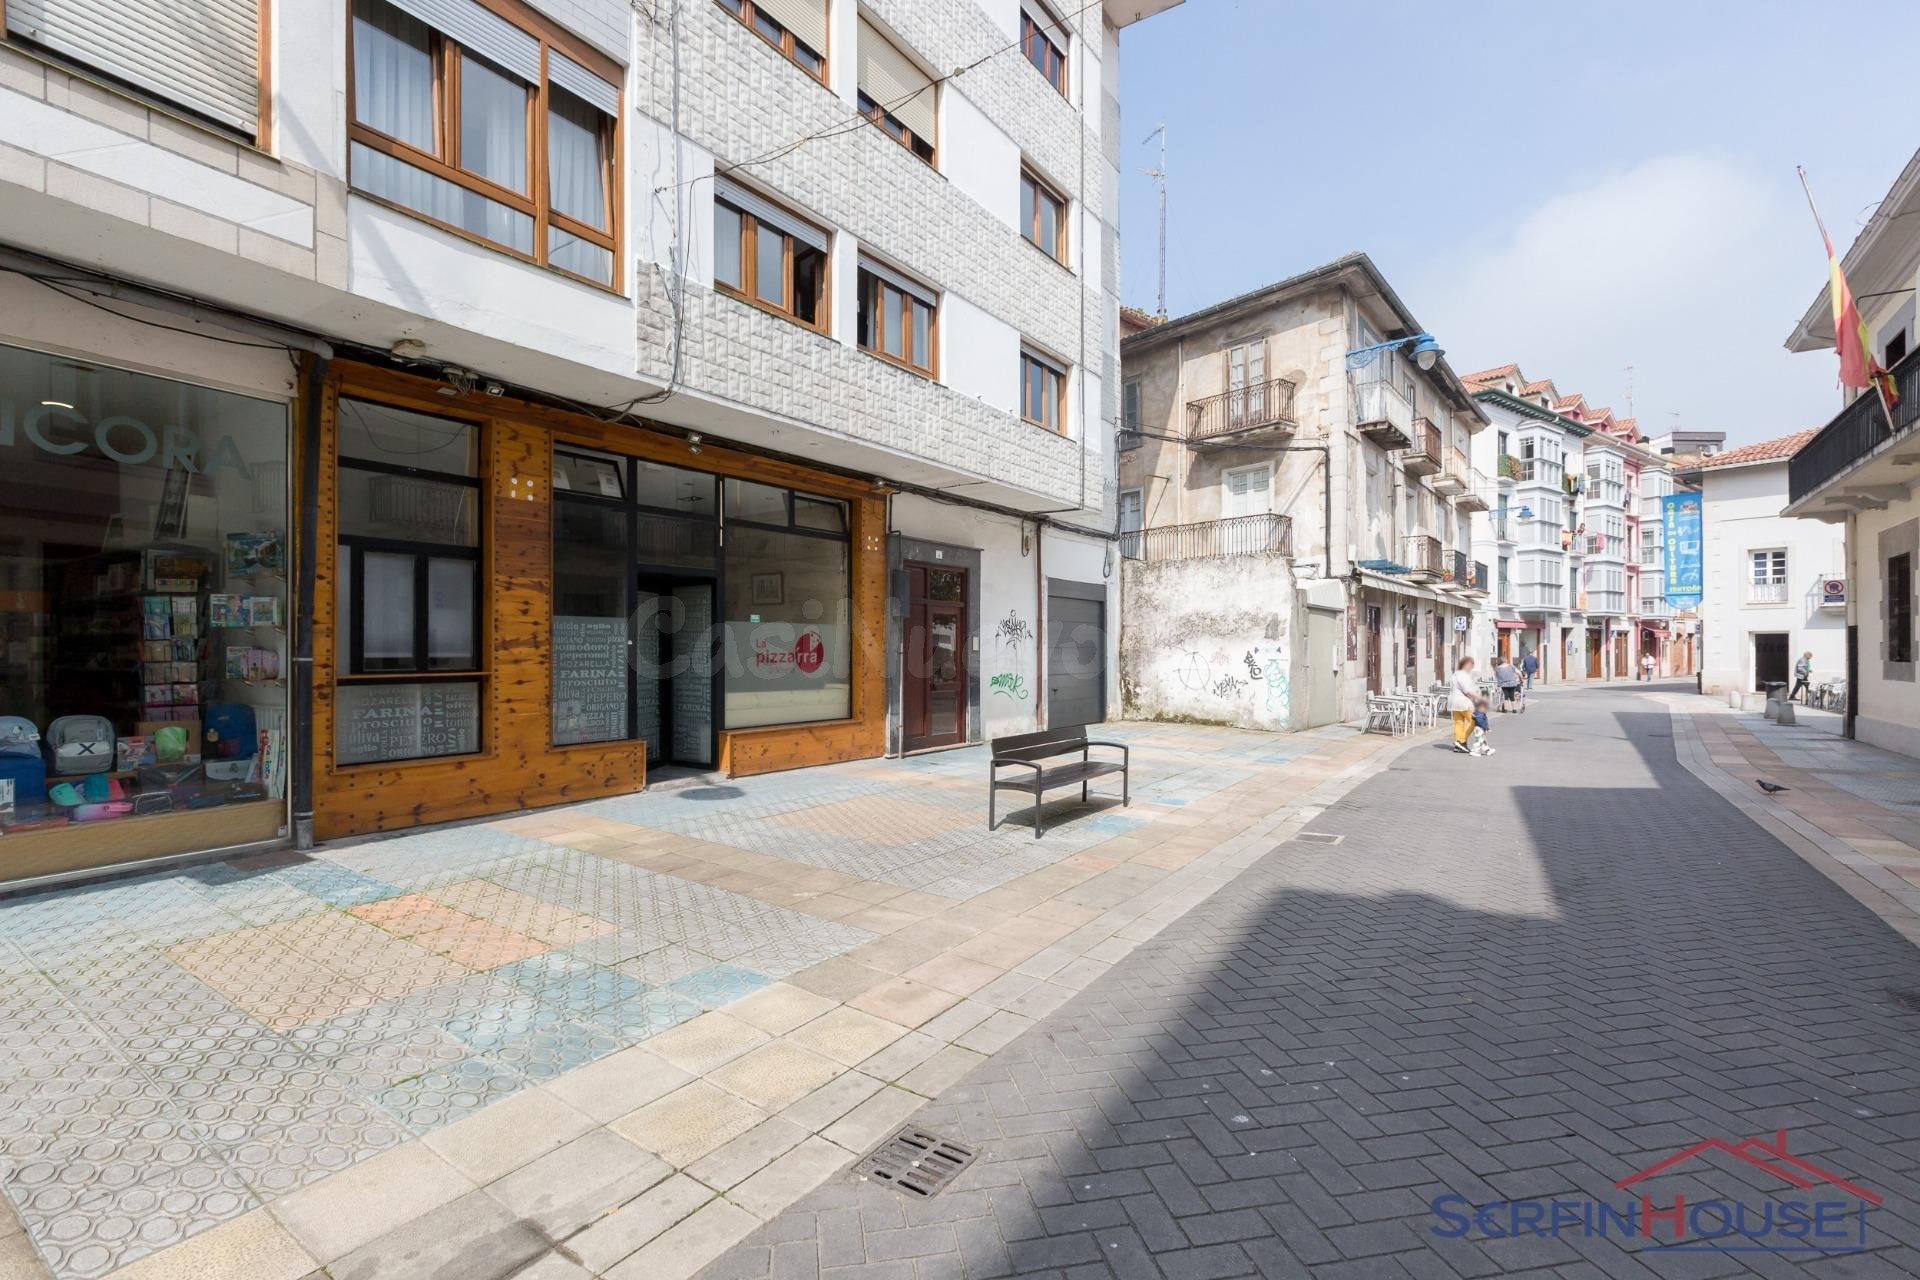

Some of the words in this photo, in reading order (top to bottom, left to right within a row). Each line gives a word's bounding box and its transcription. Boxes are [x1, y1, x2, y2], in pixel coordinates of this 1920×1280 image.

[756, 640, 768, 648] La
[560, 669, 617, 678] FARINA
[352, 706, 433, 719] FARINA
[352, 717, 432, 731] prosciuo
[388, 745, 435, 758] ORIGNO
